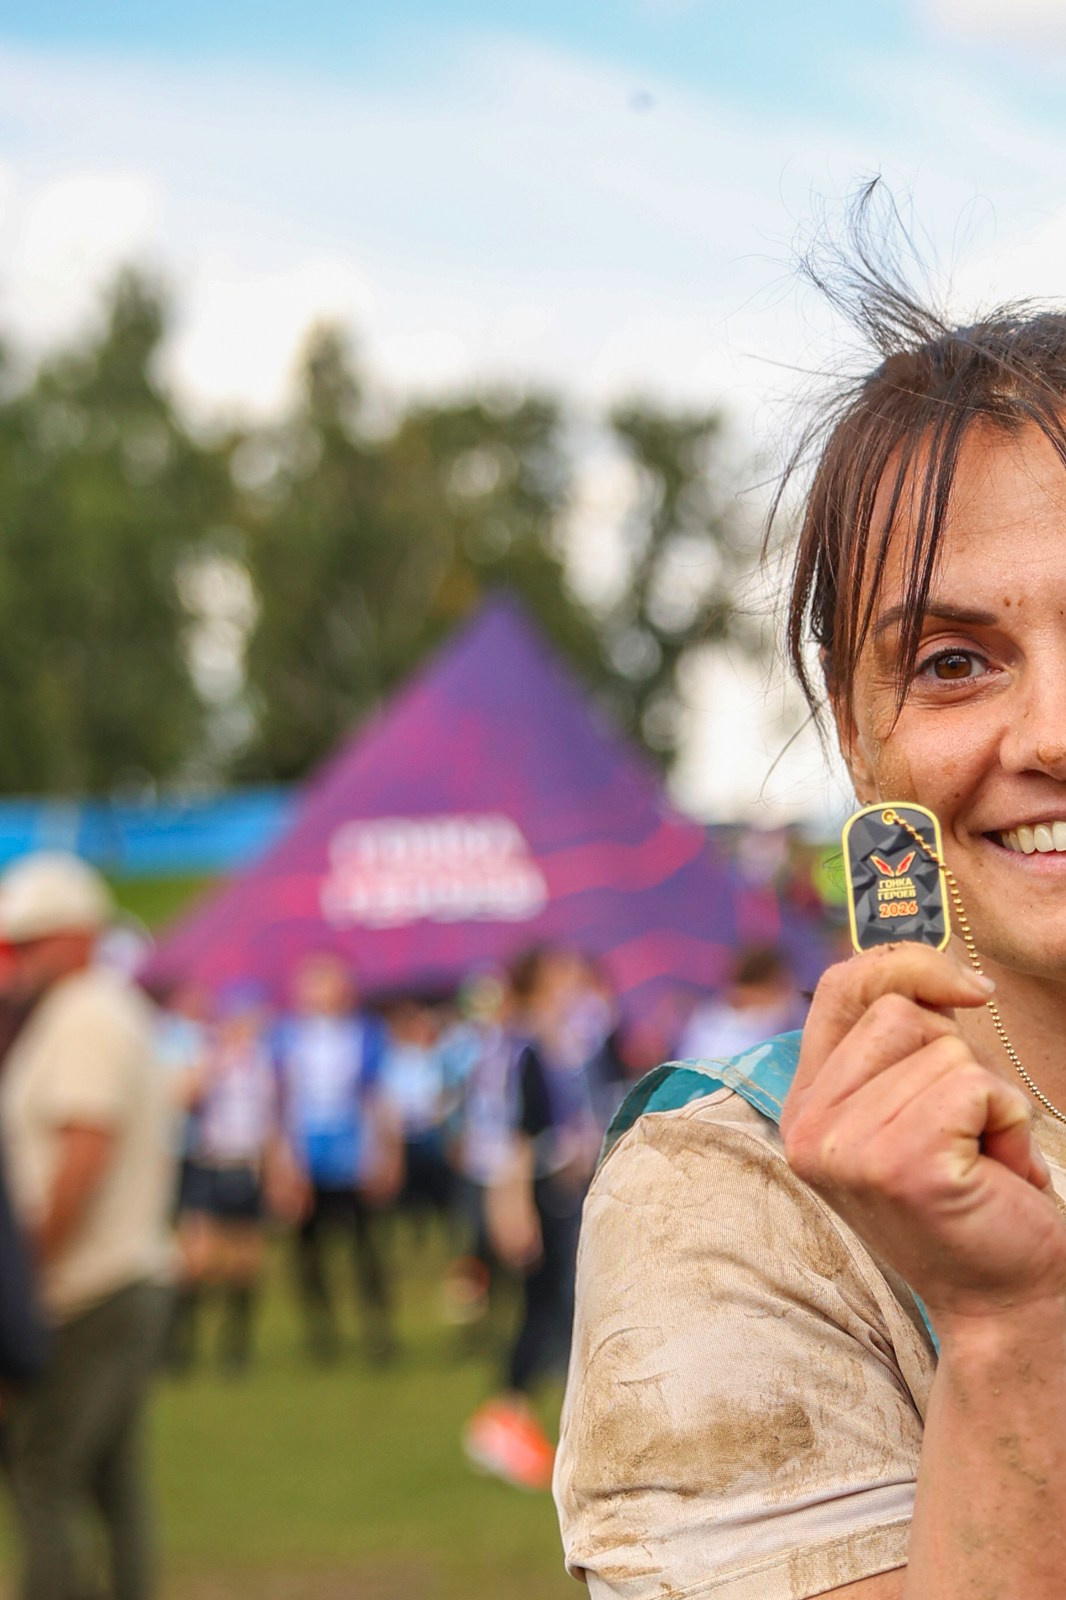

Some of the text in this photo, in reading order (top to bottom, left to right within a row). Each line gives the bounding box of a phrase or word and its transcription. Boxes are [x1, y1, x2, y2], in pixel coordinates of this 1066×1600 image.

[879, 877, 913, 889] ГОНКА
[878, 891, 916, 901] ГЕРОЕВ
[880, 902, 918, 918] 2026
